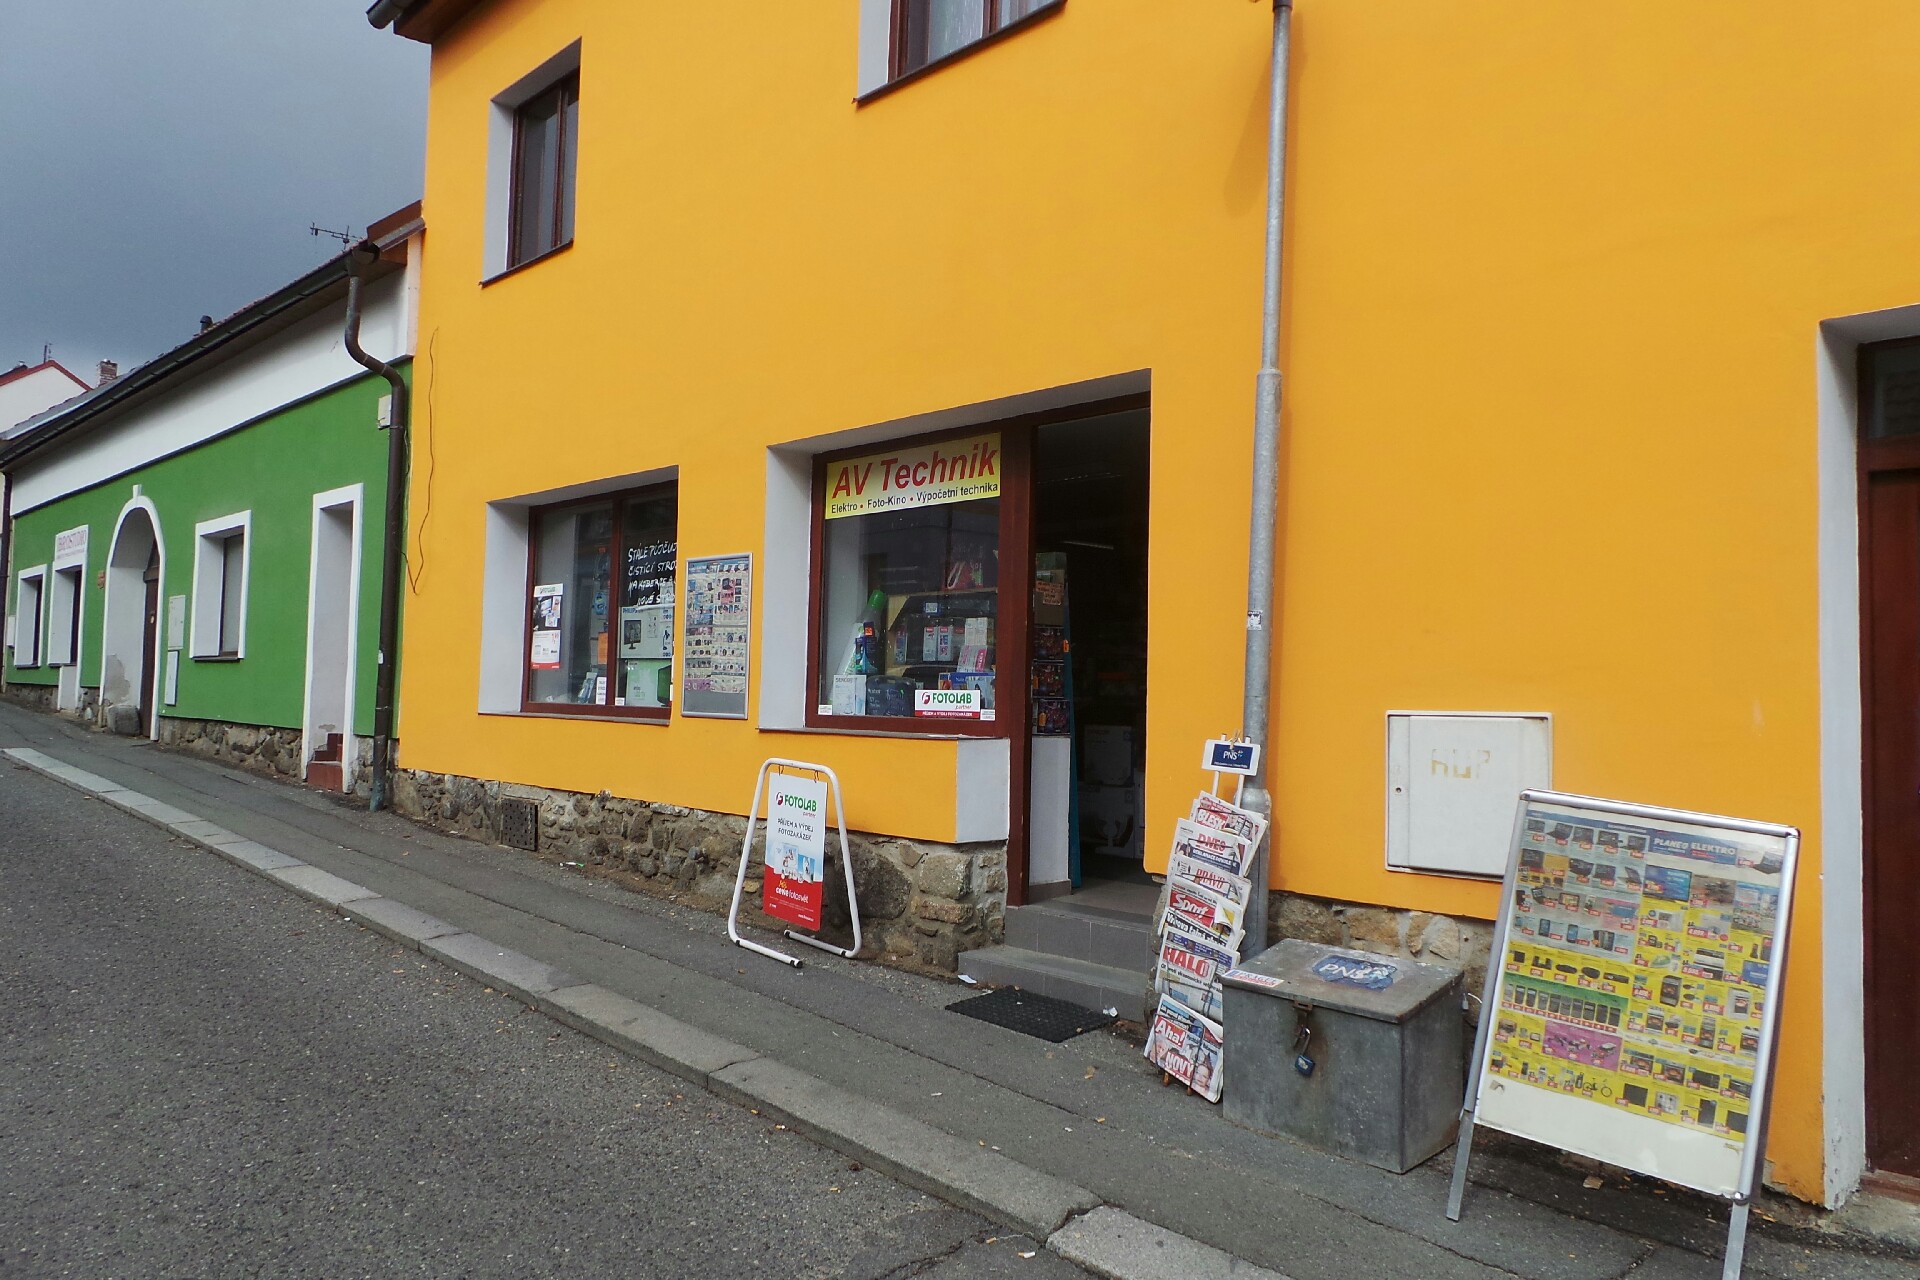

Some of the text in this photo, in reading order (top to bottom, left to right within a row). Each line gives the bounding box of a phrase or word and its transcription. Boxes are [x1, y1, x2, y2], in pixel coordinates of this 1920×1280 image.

[832, 442, 998, 499] AV Technik
[831, 482, 998, 514] Elektro Foto-Kino Výpočetní technika
[932, 692, 972, 705] FOTOLAB
[1223, 750, 1238, 760] PNS
[784, 794, 817, 812] FOTOLAB
[794, 821, 798, 829] A
[1691, 842, 1736, 855] ELEKTRO
[1319, 963, 1365, 979] PNS
[1155, 1019, 1186, 1047] Aha!
